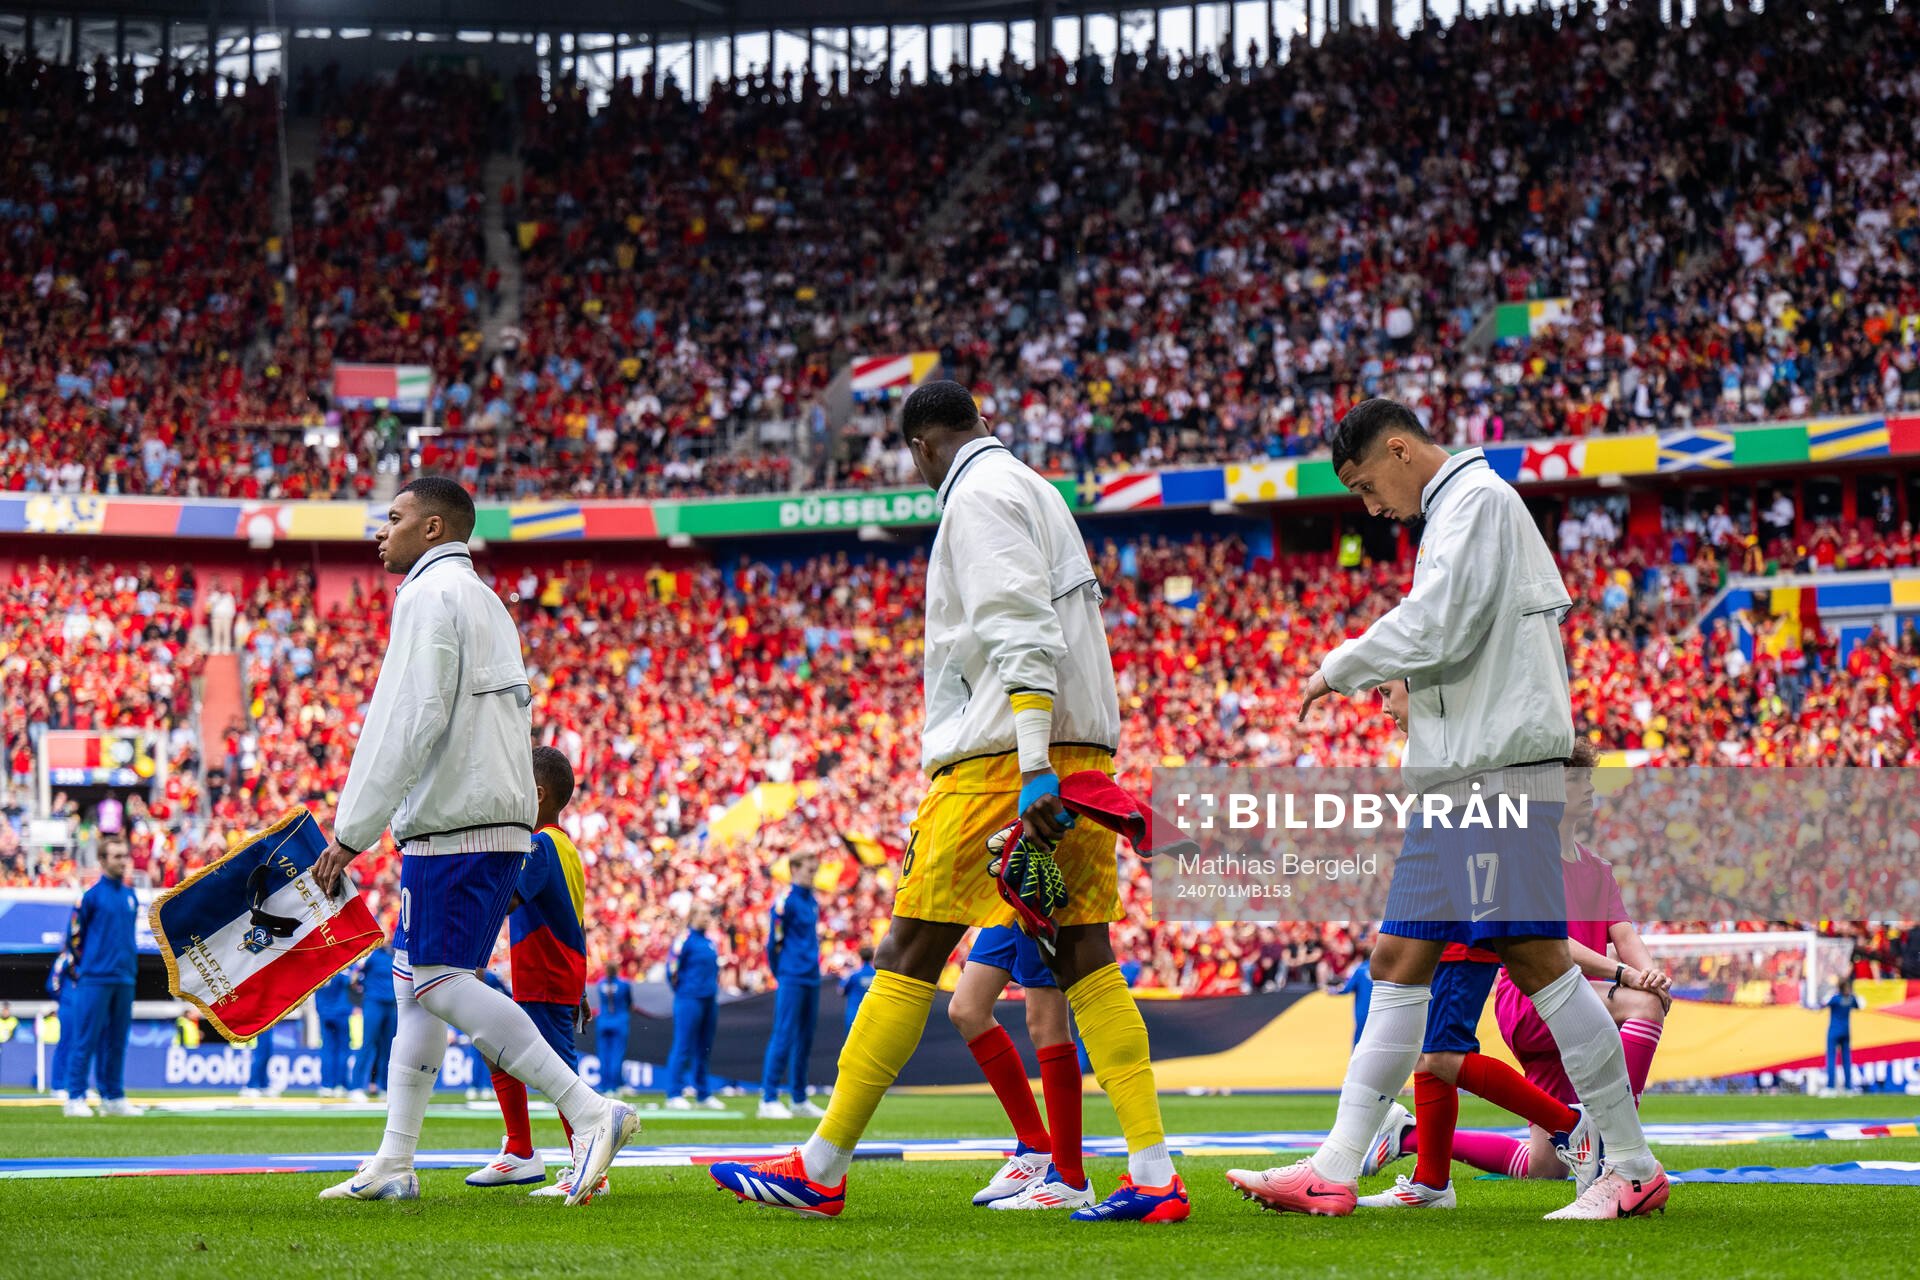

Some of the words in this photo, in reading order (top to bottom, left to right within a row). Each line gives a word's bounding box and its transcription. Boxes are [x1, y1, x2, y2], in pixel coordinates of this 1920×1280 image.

[778, 494, 942, 527] DÜSSELDO
[278, 855, 298, 878] 1/8
[293, 878, 313, 902] DE
[1466, 853, 1499, 905] 17
[182, 945, 228, 1007] ALLEMAGNE
[190, 933, 222, 973] JUILLET
[218, 974, 239, 1003] 2024
